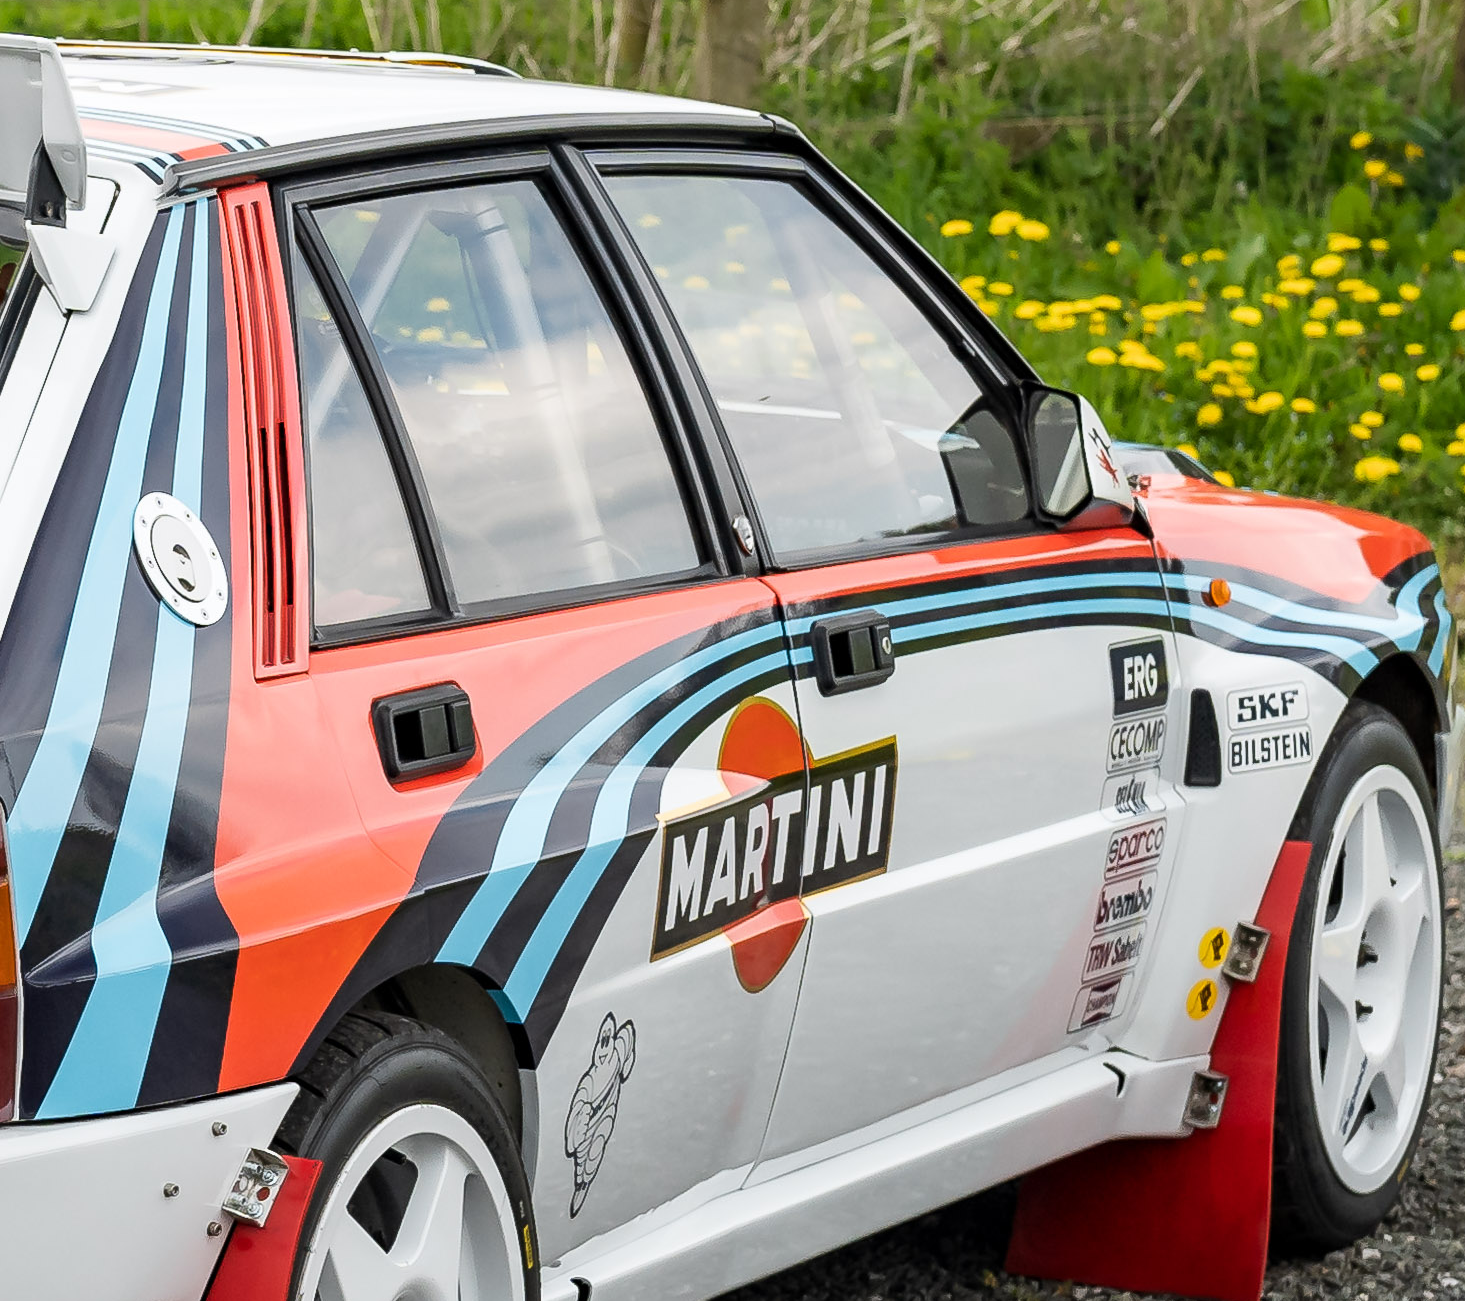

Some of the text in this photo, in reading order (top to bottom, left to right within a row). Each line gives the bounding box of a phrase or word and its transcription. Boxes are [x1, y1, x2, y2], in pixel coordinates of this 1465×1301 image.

[1123, 653, 1158, 701] ERG
[1237, 689, 1299, 723] SKF
[1110, 718, 1164, 761] CECOMP
[1231, 731, 1311, 768] BILSTEIN
[664, 764, 888, 932] MARTINI
[1108, 825, 1165, 874] sparco
[1095, 879, 1153, 925] brembo
